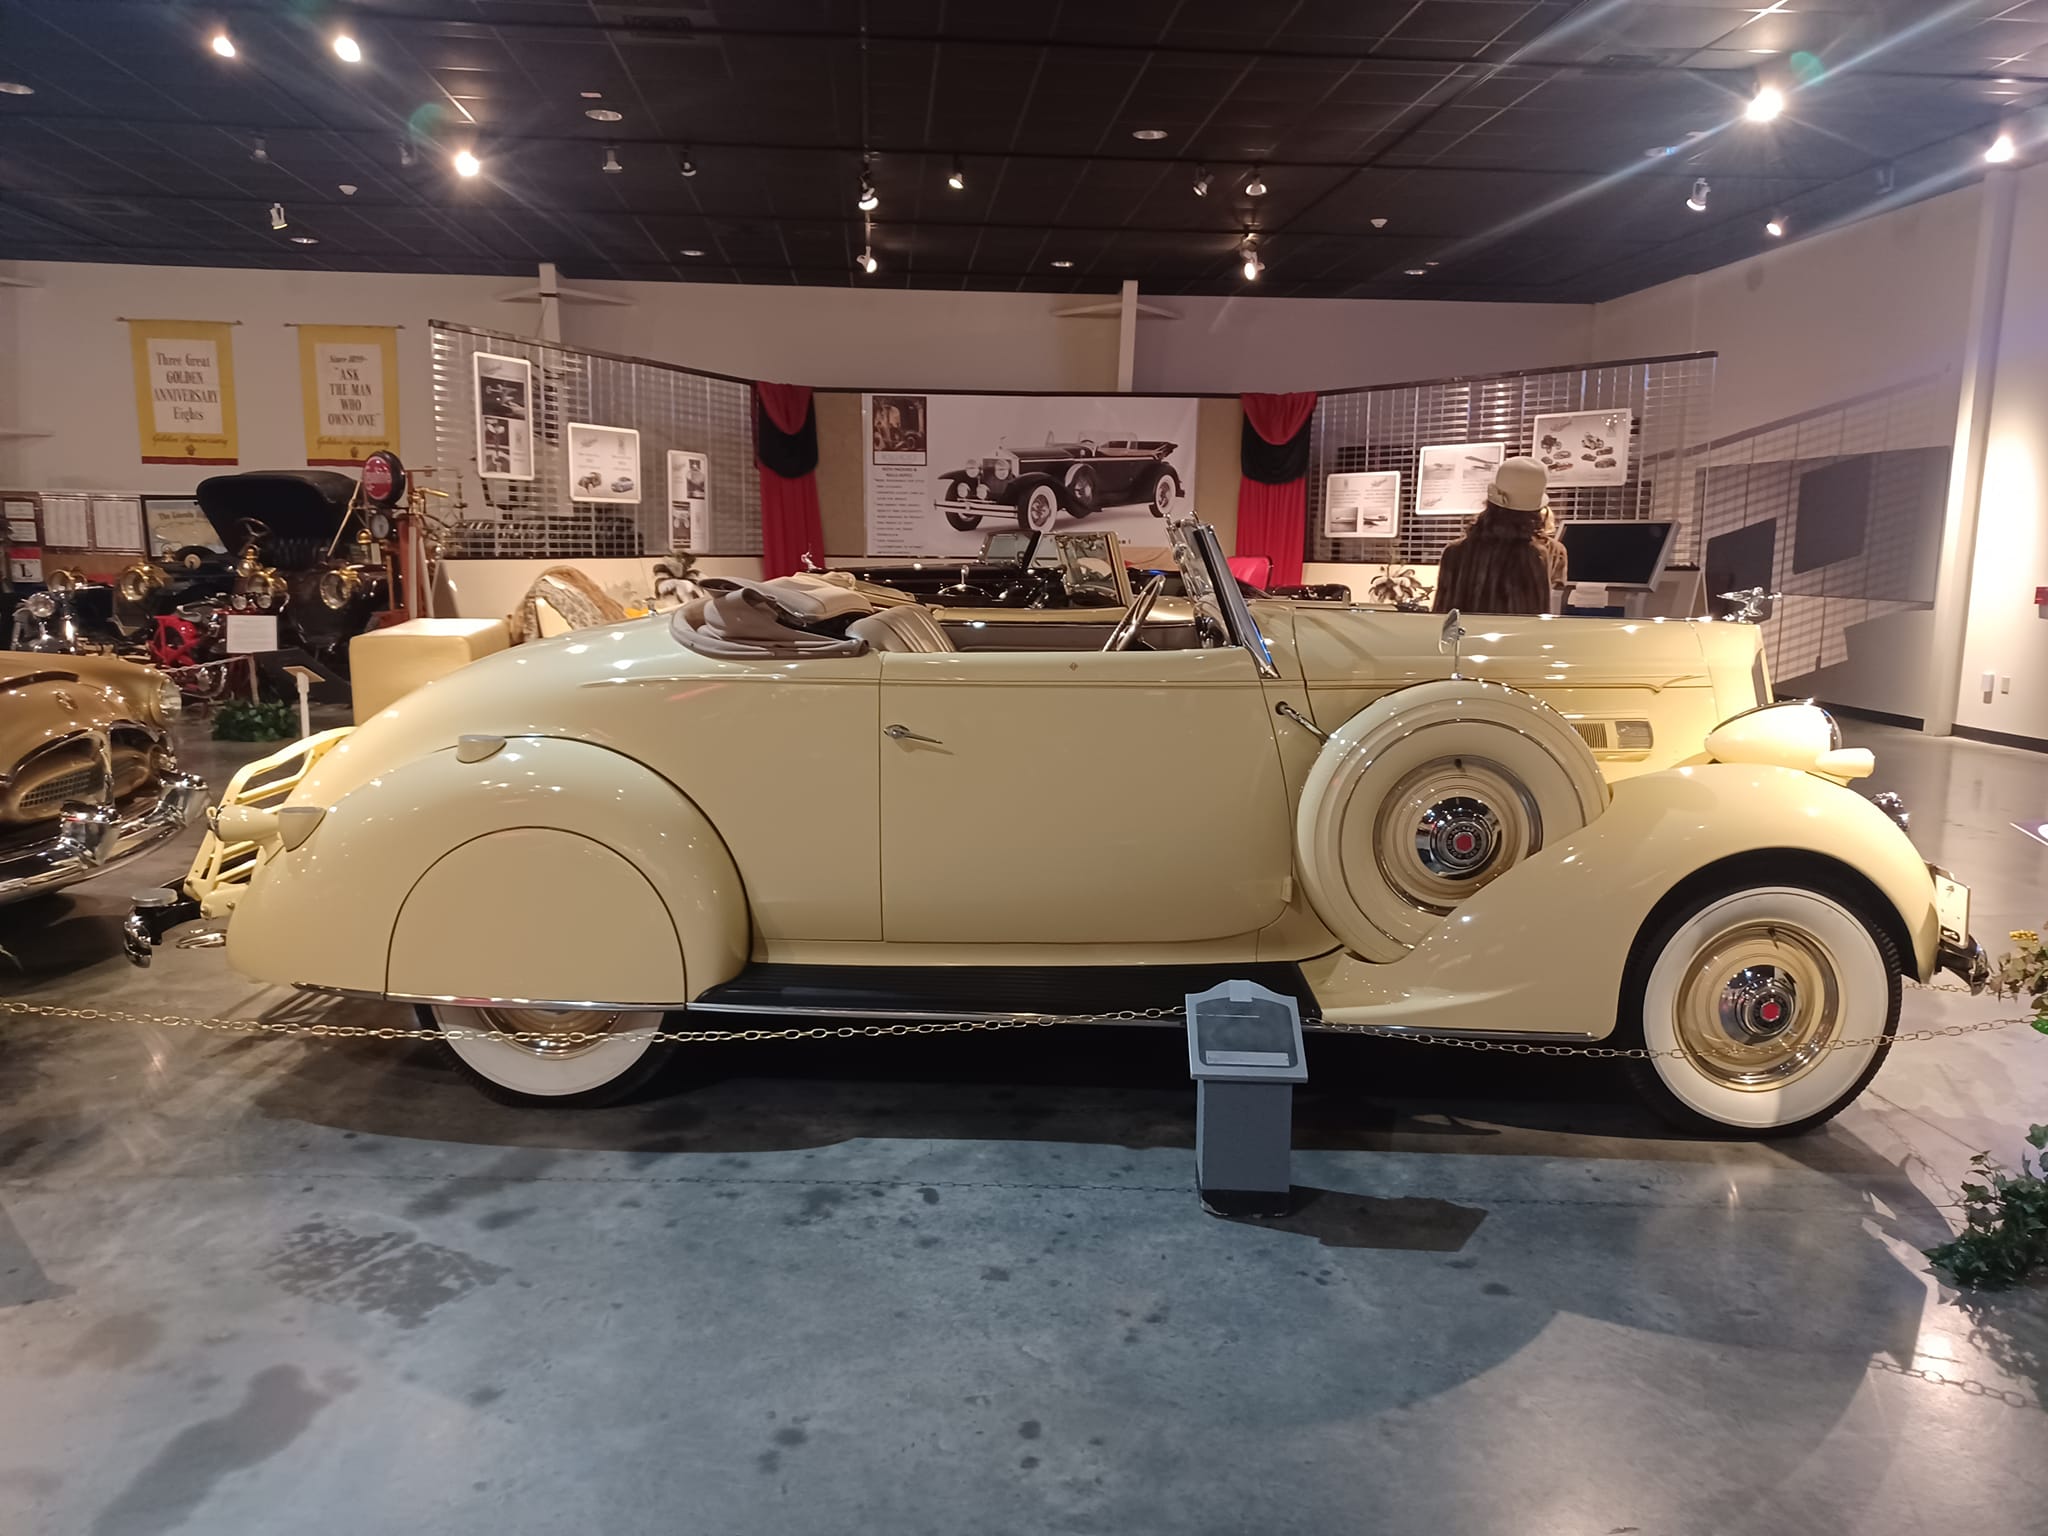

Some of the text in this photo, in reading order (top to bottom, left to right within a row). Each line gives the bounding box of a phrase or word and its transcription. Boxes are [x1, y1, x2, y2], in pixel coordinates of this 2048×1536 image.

[156, 352, 210, 367] Three Great
[166, 371, 204, 384] GOLDEN
[153, 388, 218, 403] ANNIVERSARY
[329, 384, 372, 396] THE MAN
[340, 399, 362, 411] WHO
[173, 406, 204, 423] Eights
[328, 413, 354, 426] OWNS
